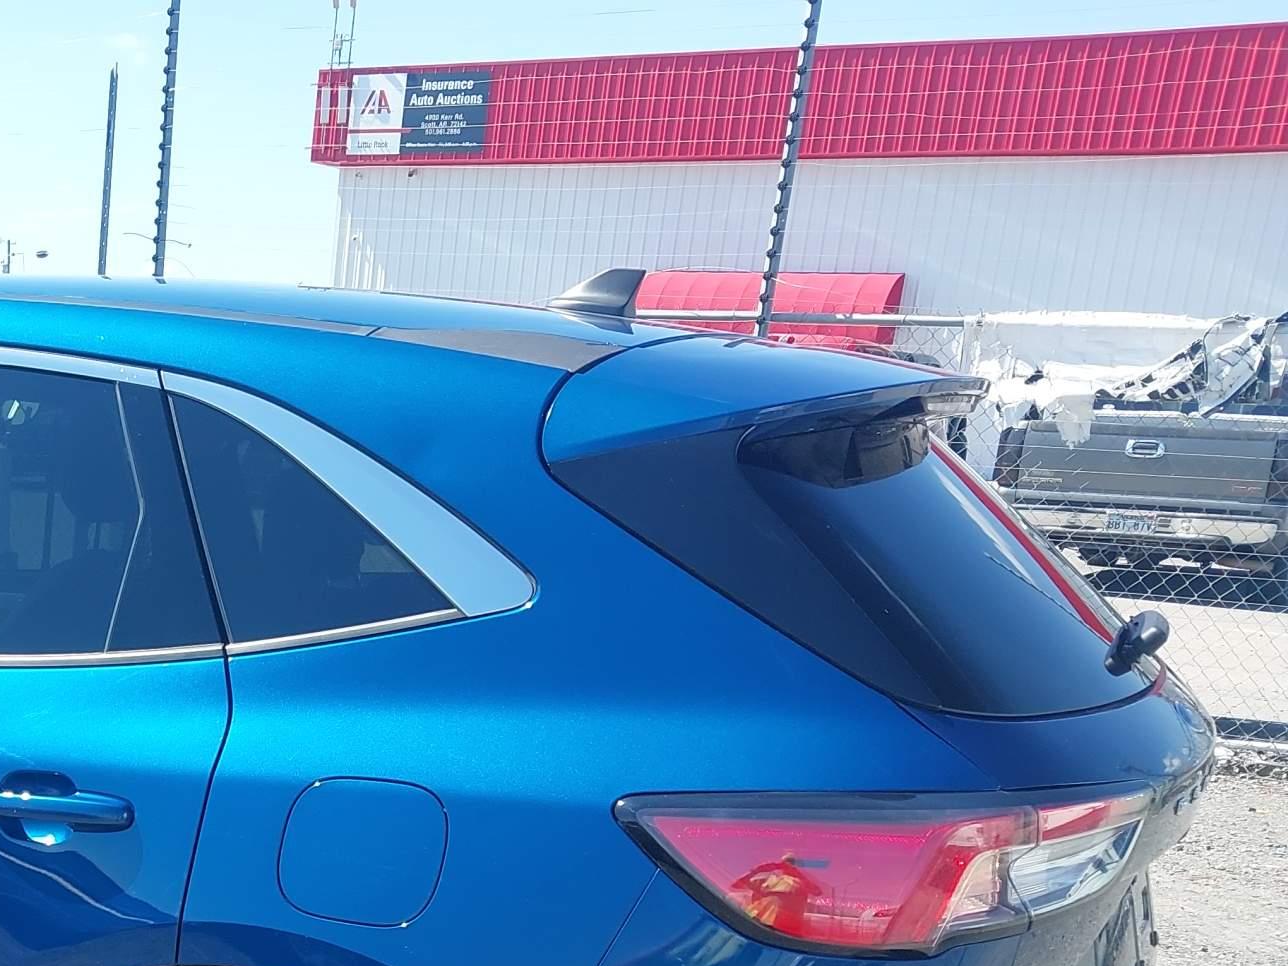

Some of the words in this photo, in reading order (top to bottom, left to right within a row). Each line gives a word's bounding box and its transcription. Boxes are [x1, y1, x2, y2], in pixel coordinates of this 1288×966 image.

[422, 79, 473, 91] Insurance
[409, 93, 433, 106] Auto
[436, 92, 483, 105] Auctions
